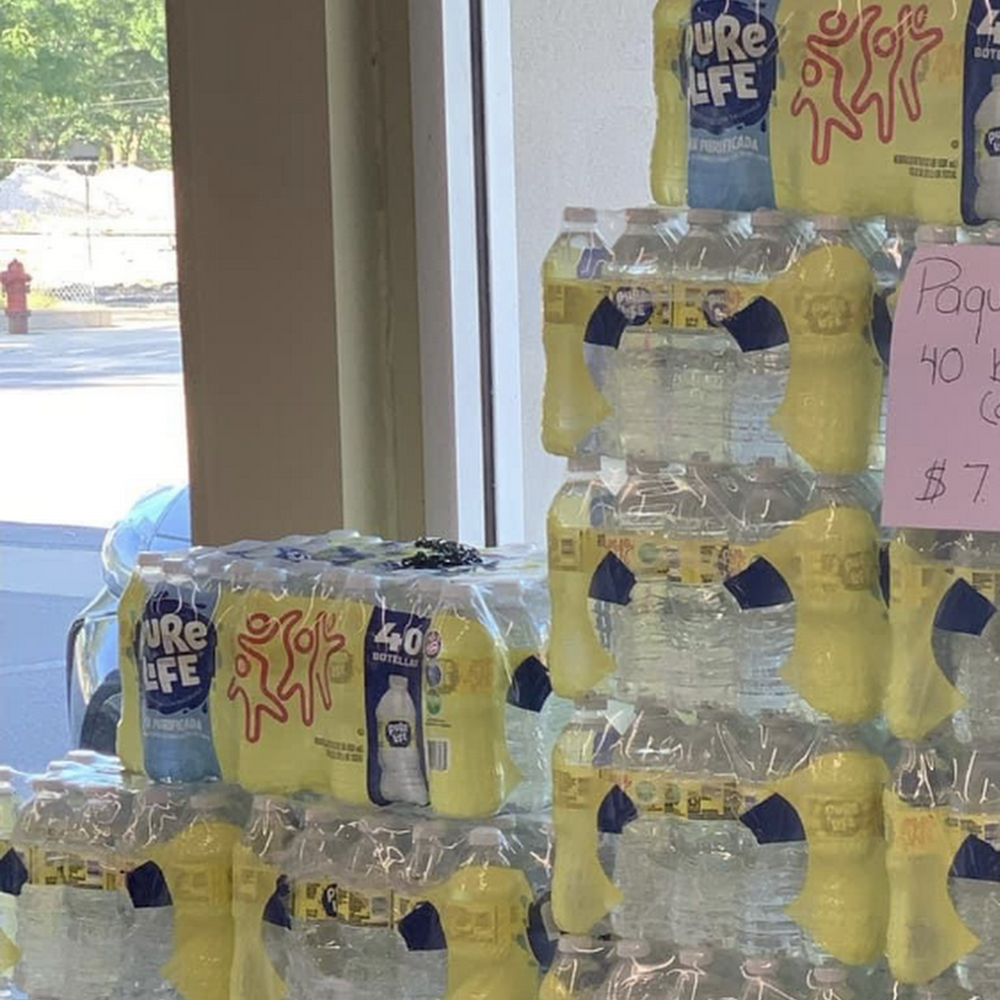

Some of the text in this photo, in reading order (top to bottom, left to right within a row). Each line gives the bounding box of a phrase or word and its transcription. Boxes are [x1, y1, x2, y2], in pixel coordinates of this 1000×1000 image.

[920, 344, 964, 385] 40
[374, 622, 423, 655] 40
[372, 652, 419, 667] BOTELLAS
